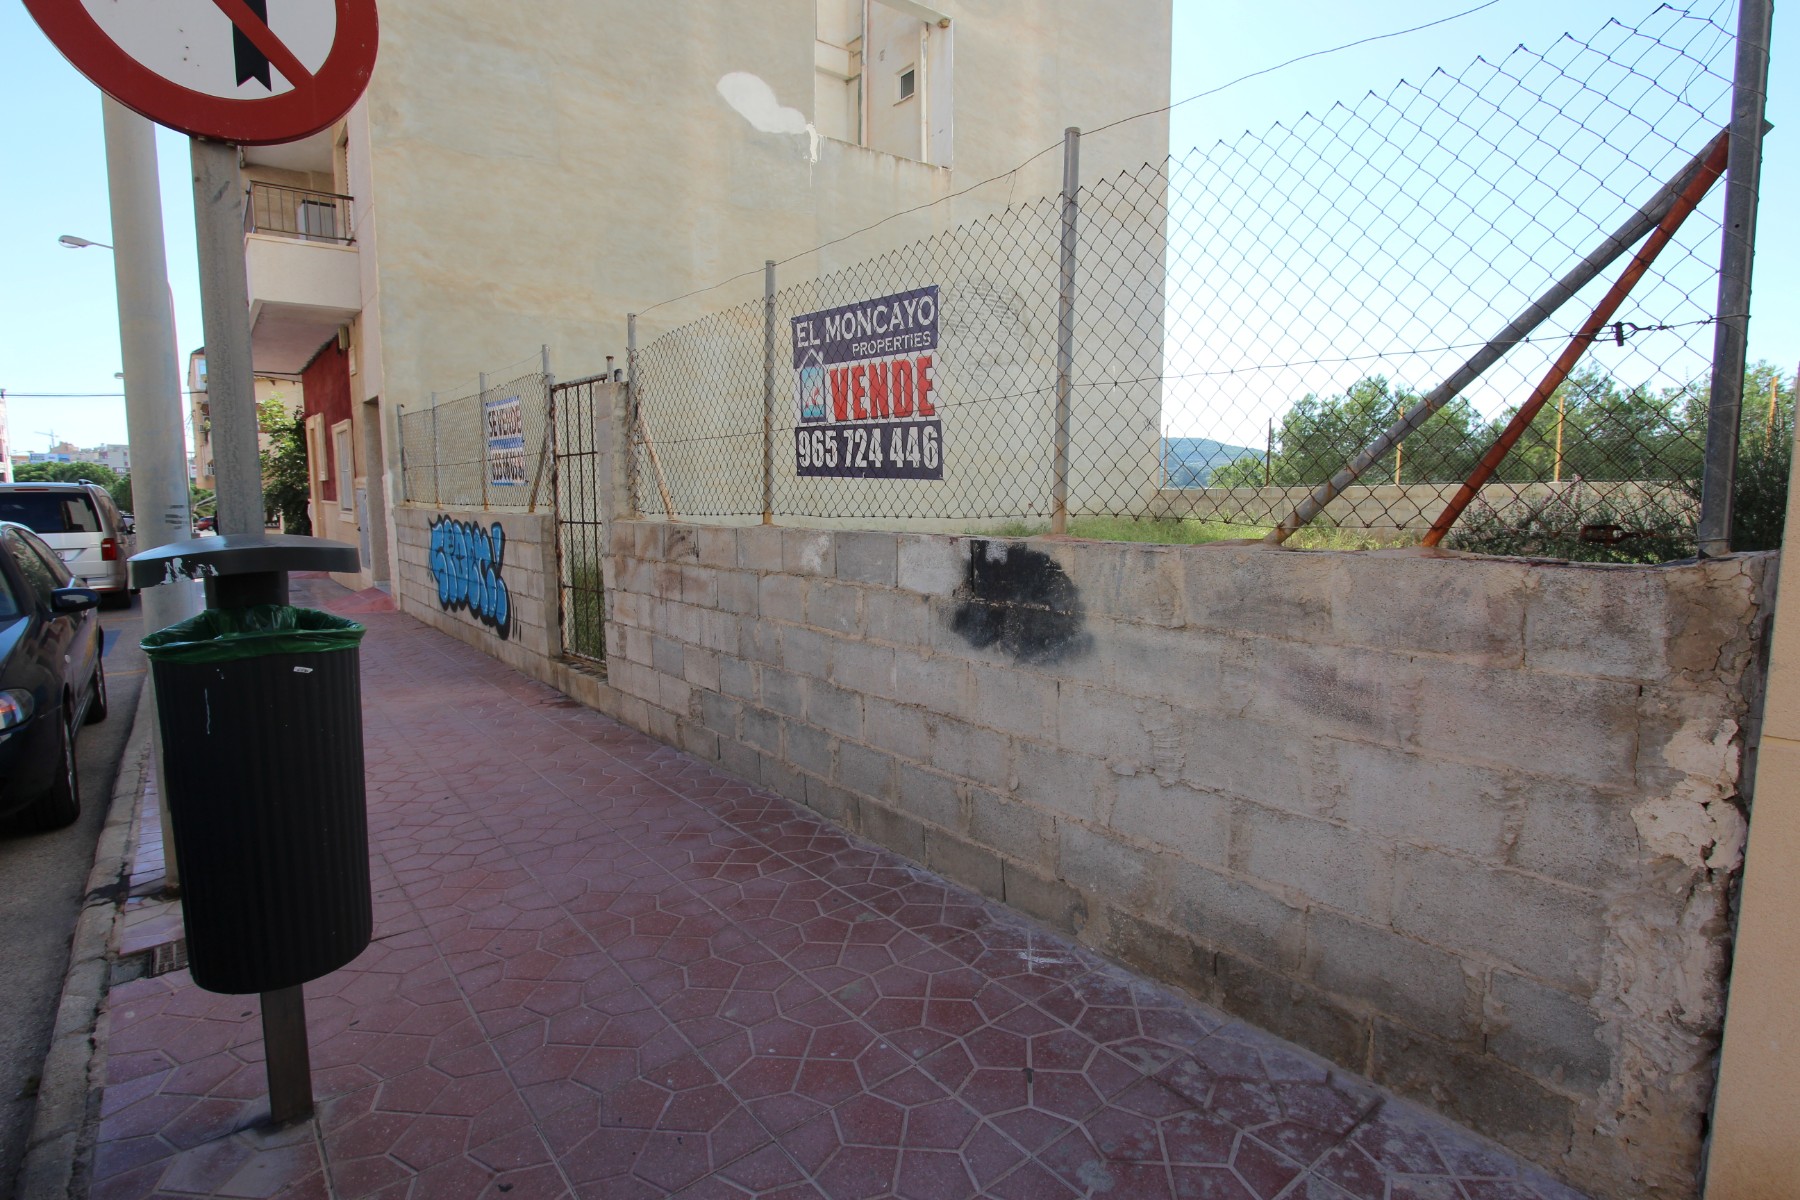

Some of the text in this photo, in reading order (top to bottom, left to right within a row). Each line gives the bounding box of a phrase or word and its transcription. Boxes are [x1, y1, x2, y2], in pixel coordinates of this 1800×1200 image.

[796, 295, 935, 348] EL MONCAYO
[852, 330, 931, 357] PROPERTIES
[829, 355, 935, 422] VENDE
[798, 425, 939, 470] 965 724 446
